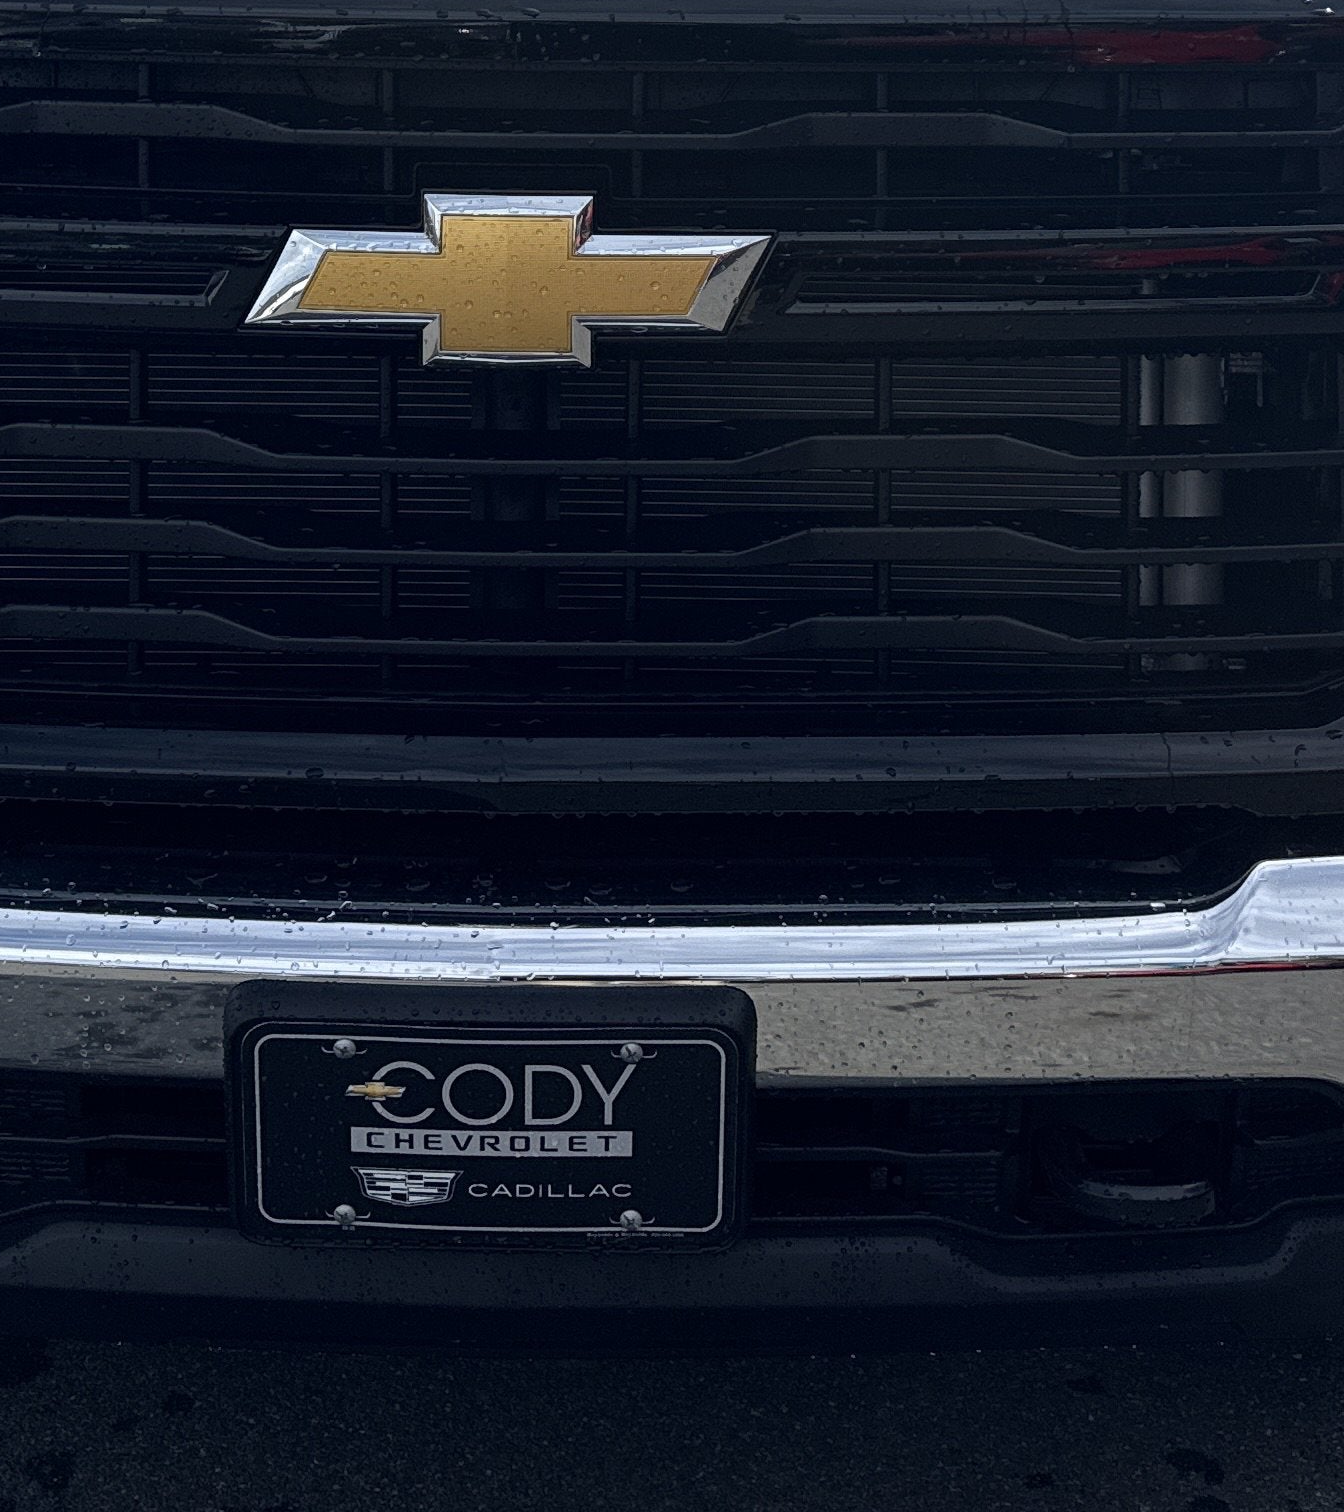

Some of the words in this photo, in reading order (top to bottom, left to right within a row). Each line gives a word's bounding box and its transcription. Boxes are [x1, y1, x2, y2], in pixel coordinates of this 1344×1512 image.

[371, 1061, 637, 1126] CODY
[366, 1131, 619, 1153] CHEVROLET
[468, 1183, 633, 1199] CADILLAC
